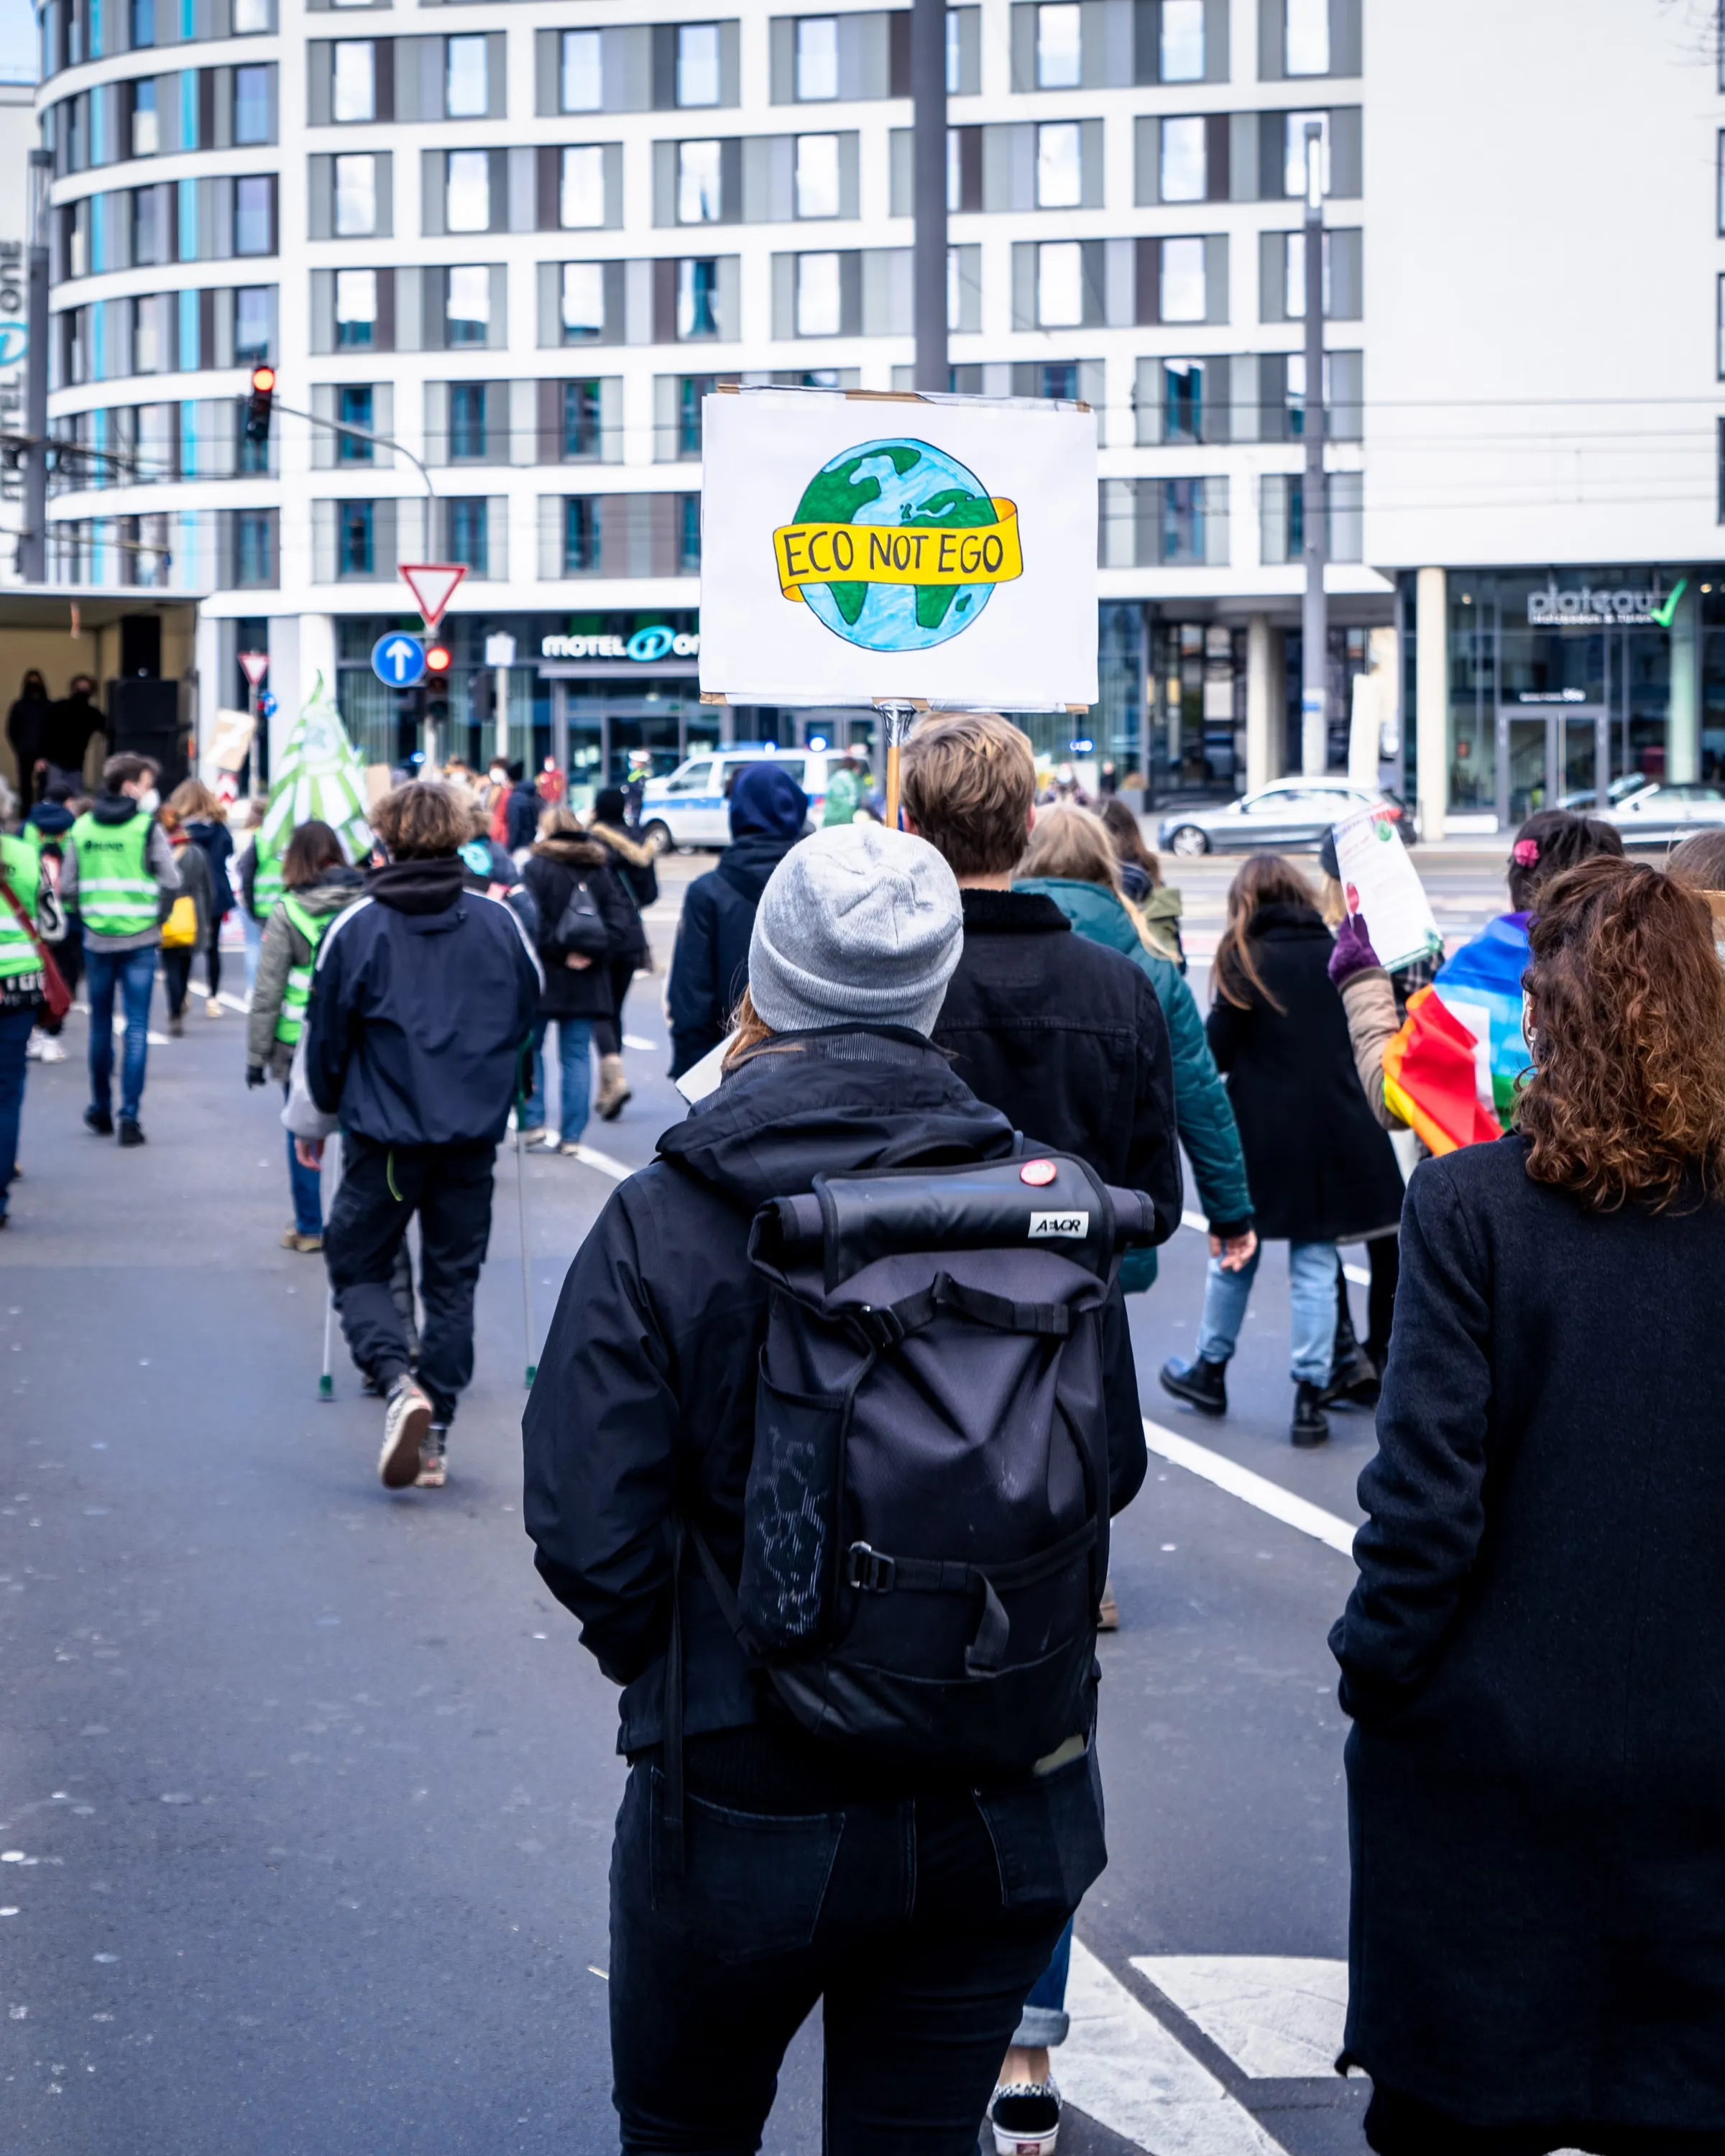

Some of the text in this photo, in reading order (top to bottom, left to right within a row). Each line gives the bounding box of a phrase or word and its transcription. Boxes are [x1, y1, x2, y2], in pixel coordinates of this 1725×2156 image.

[783, 530, 1003, 576] ECO NOT EGO
[542, 635, 627, 657] MOTEL
